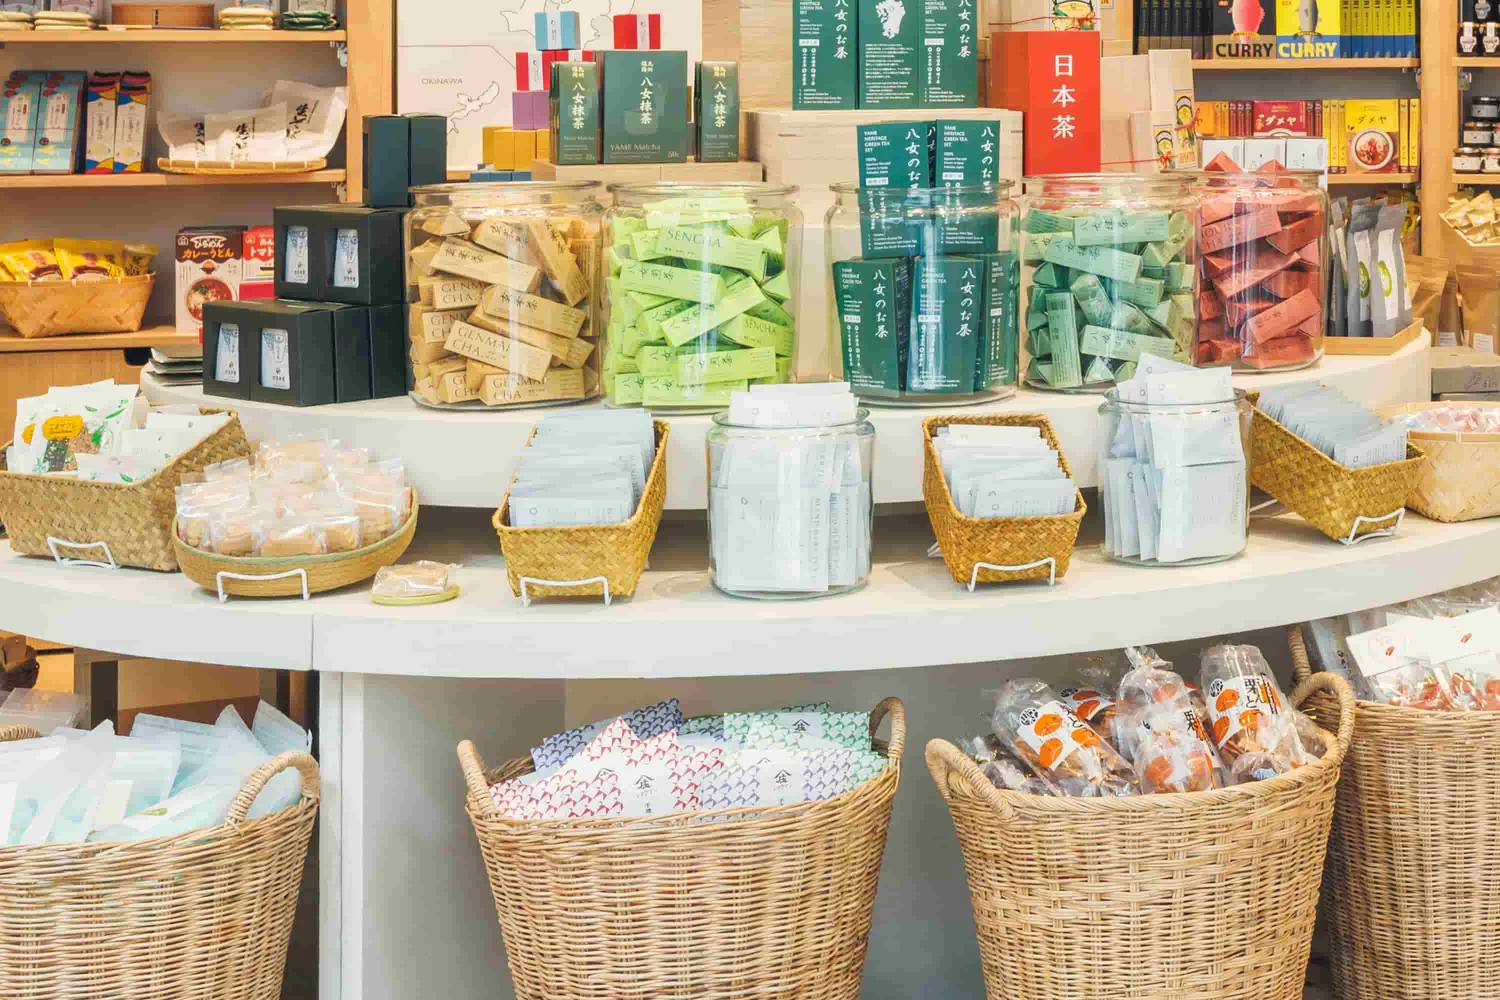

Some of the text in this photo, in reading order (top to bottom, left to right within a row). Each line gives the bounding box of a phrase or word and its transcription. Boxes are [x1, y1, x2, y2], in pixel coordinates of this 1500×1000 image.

[1215, 44, 1273, 57] CURRY
[1278, 42, 1337, 58] CURRY
[421, 78, 463, 86] OKINAWA
[1052, 54, 1076, 139] 日本茶
[572, 82, 585, 130] 八女抹茶
[640, 77, 653, 125] 八女抹茶
[714, 81, 727, 128] 八女抹茶
[182, 248, 234, 259] カレーうどん
[873, 269, 889, 338] 八女のお茶
[956, 267, 976, 337] 八女のお茶
[458, 325, 511, 352] GENMAI
[743, 319, 777, 336] SENCHA
